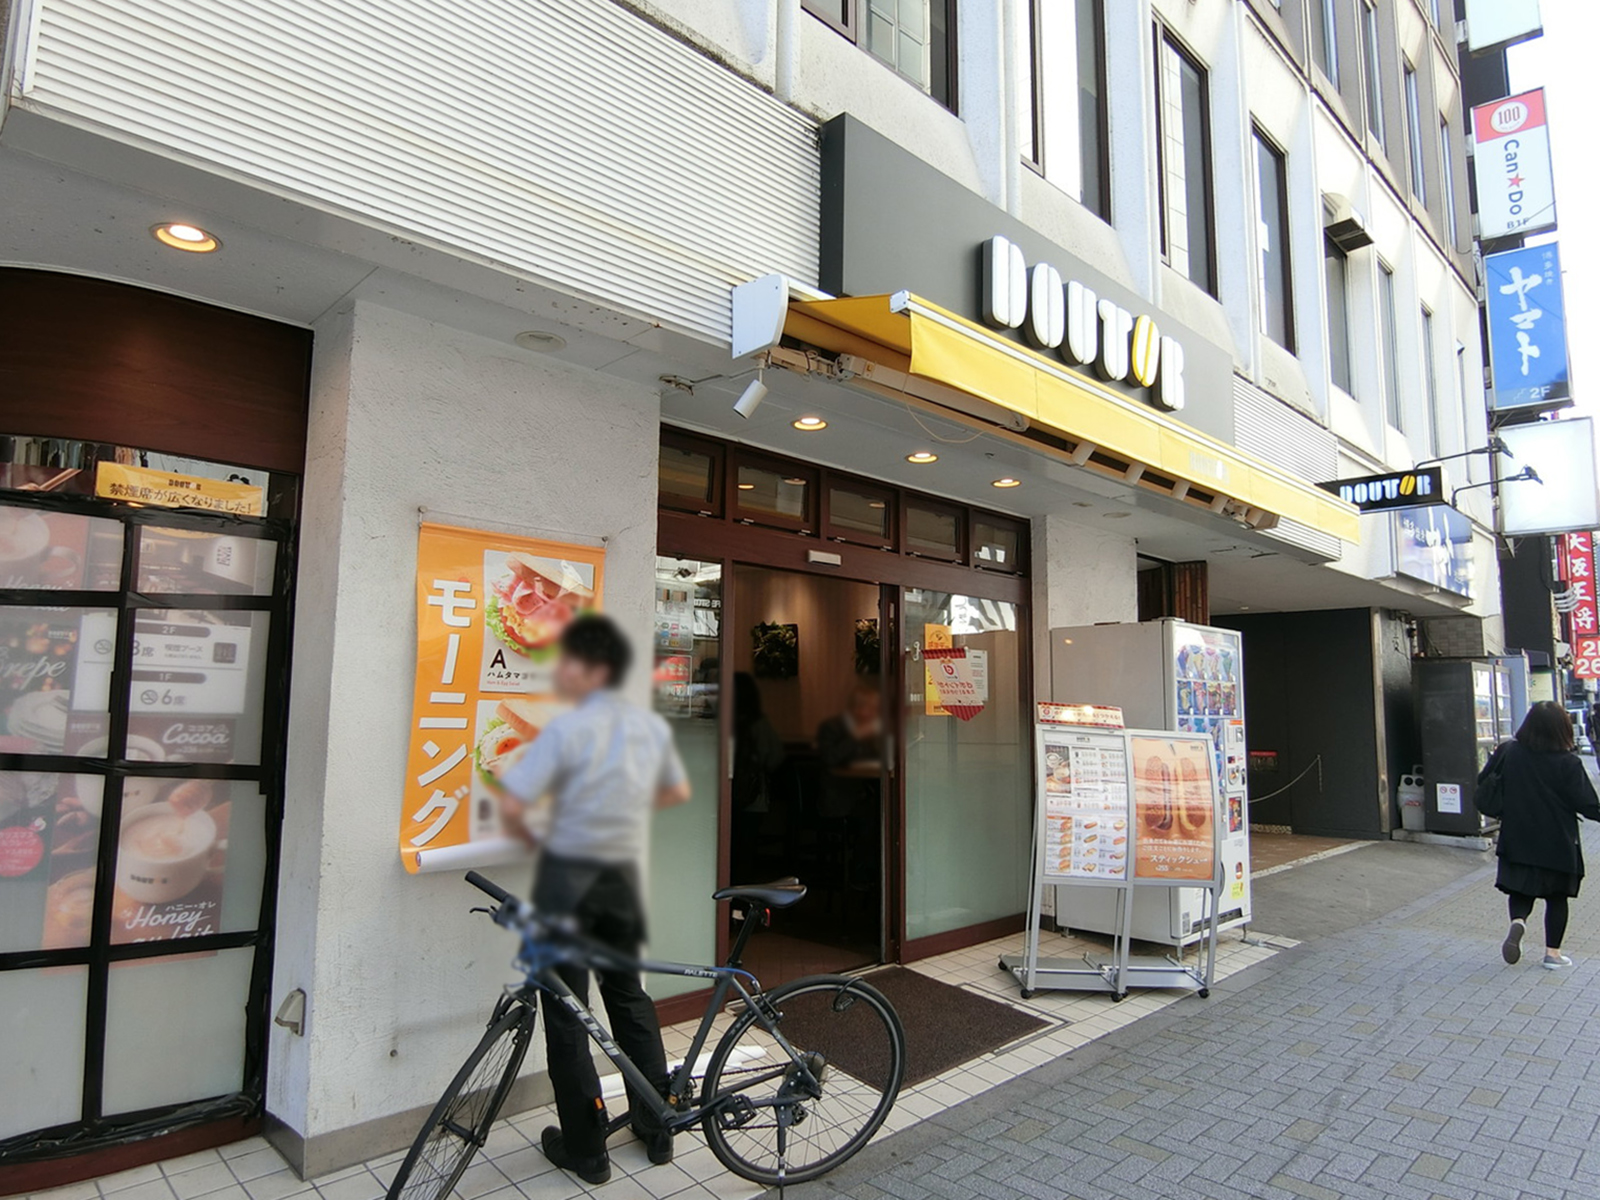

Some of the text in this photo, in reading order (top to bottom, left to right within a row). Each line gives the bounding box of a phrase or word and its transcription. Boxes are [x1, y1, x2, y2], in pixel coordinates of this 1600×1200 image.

[1498, 106, 1520, 126] 100
[988, 235, 1185, 412] DOUTOR
[1530, 386, 1550, 399] 2F
[1340, 475, 1431, 503] DOUTOR
[489, 648, 507, 669] A
[1582, 641, 1600, 656] 2
[410, 578, 477, 848] モーニング
[162, 723, 230, 744] Cocoa
[125, 905, 212, 932] Honey
[561, 995, 620, 1056] FUJI
